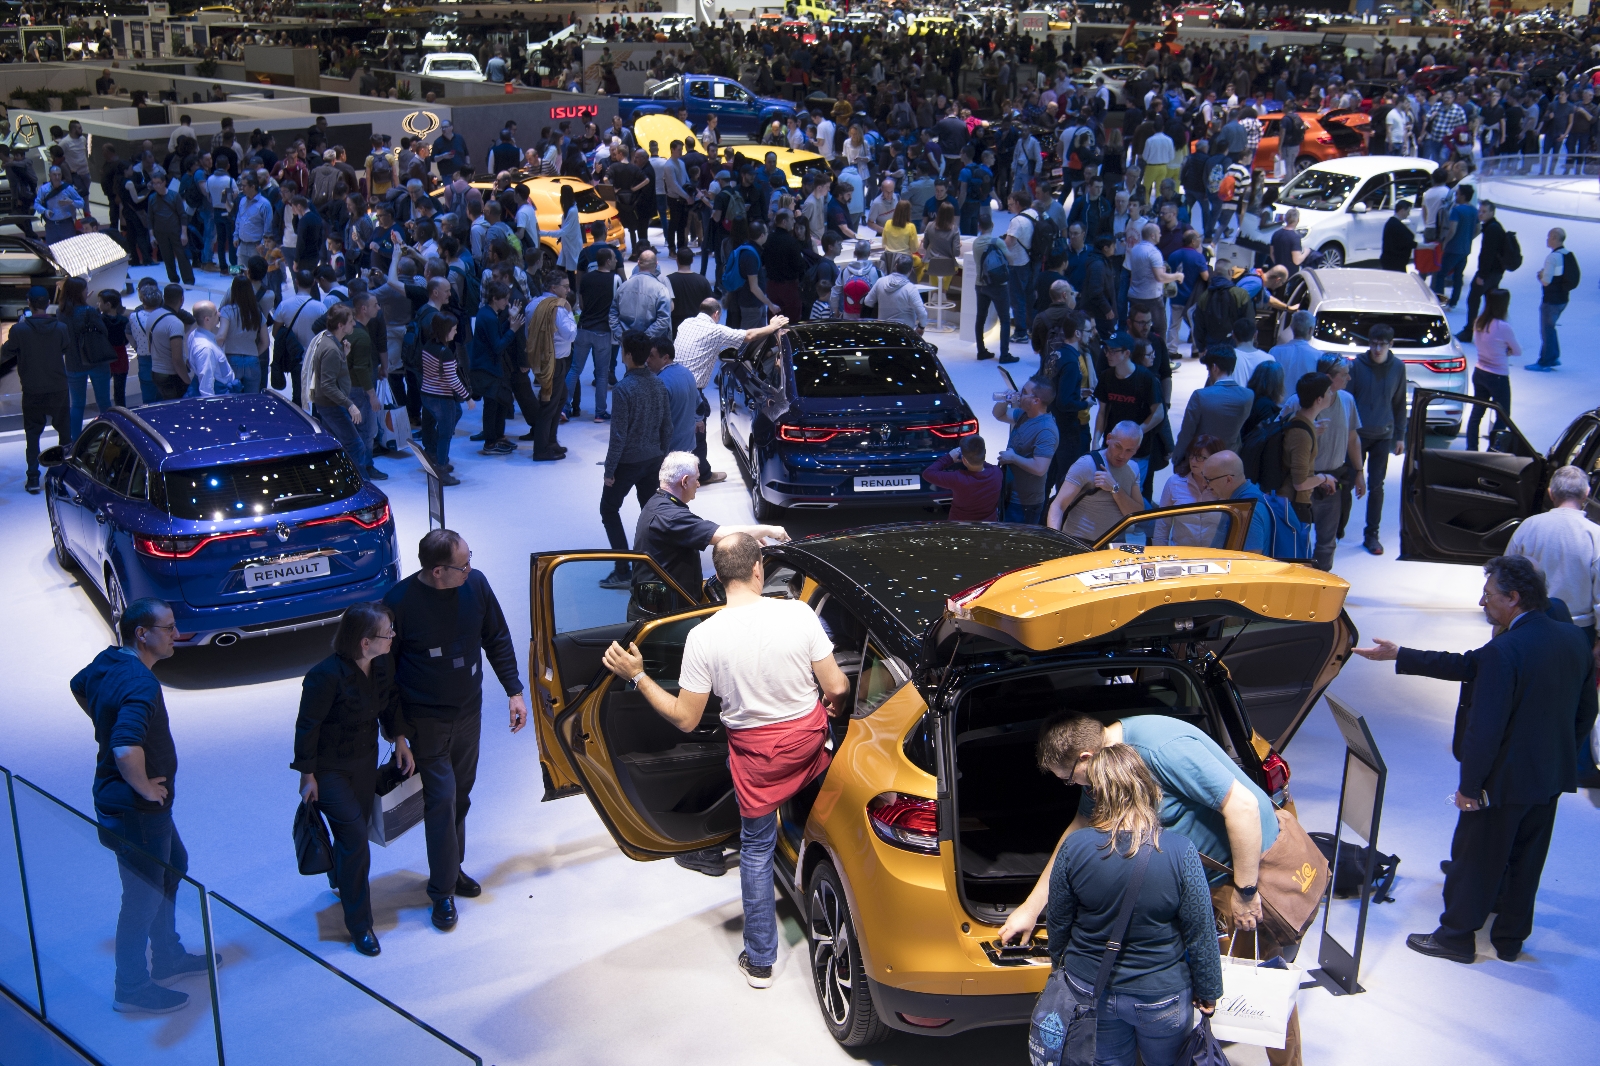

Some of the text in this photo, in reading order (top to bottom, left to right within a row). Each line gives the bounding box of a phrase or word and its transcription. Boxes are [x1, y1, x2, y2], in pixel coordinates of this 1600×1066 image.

[550, 104, 598, 119] ISUZU
[1107, 392, 1136, 403] STEYR
[861, 478, 912, 488] RENAULT
[254, 562, 320, 582] RENAULT
